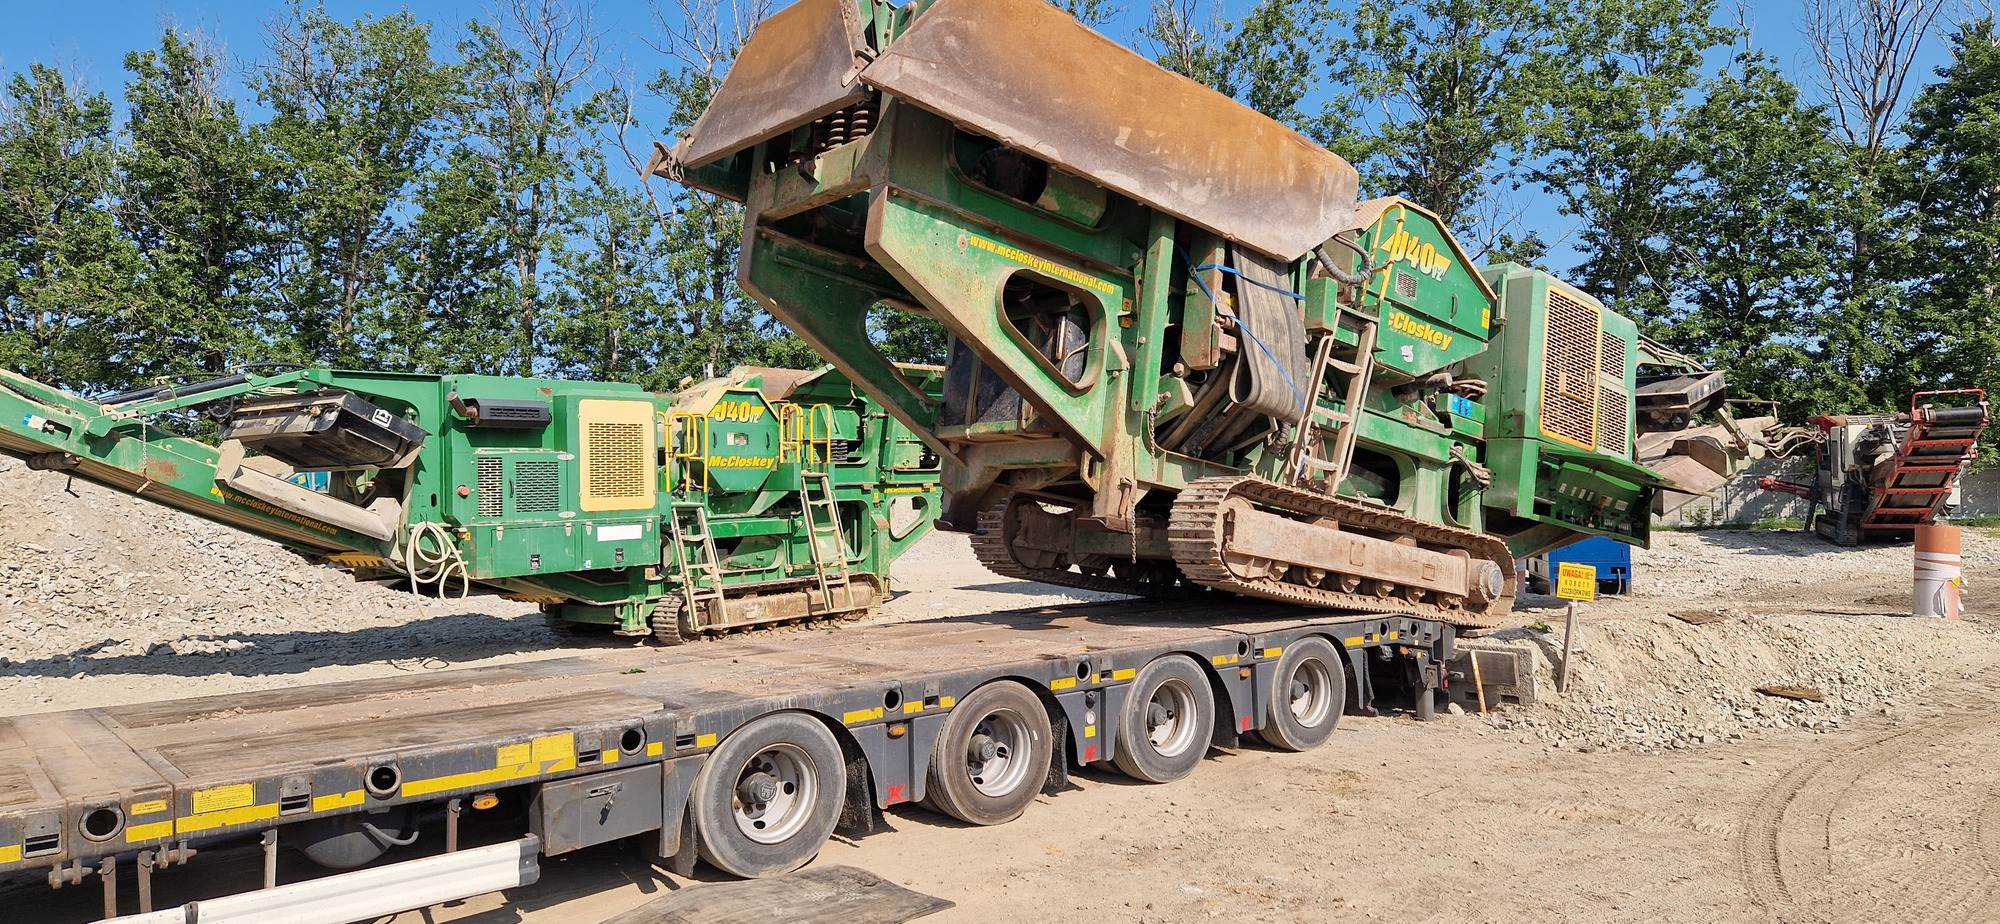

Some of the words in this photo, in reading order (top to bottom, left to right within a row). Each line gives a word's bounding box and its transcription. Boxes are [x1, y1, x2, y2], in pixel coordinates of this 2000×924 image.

[969, 235, 1115, 295] www.mccloskeyinternational.com
[714, 400, 751, 423] J40
[708, 456, 775, 469] McCloskey
[1562, 568, 1583, 578] UWAGA!
[1564, 580, 1590, 588] ROBOTY
[1084, 745, 1099, 762] K
[886, 784, 907, 805] K
